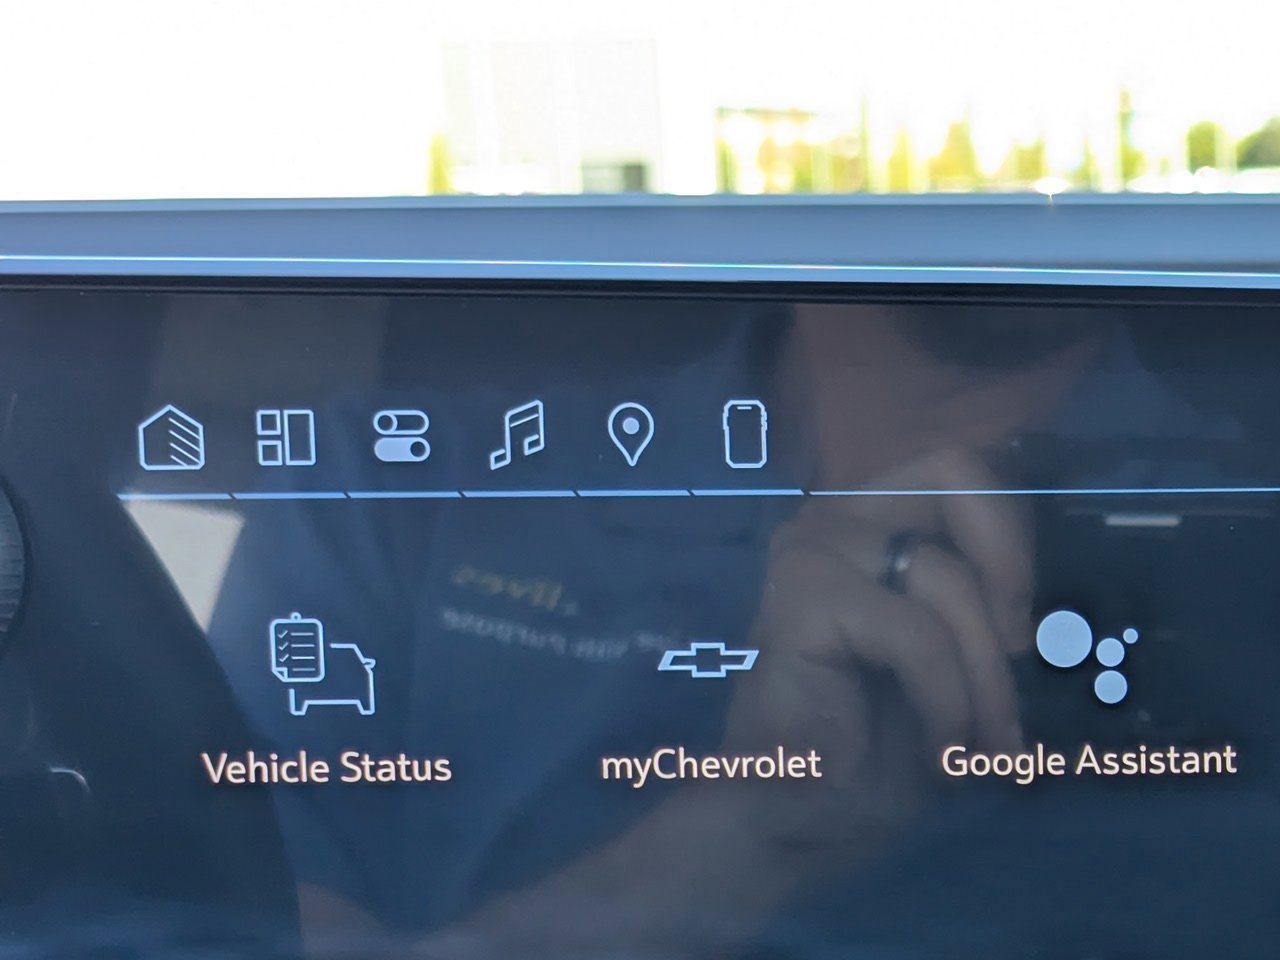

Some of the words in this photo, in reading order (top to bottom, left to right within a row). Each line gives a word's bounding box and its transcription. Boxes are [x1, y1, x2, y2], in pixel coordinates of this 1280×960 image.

[201, 750, 330, 784] Vehicle
[340, 751, 452, 783] Status
[602, 745, 823, 789] myChevrolet
[941, 743, 1066, 785] Google
[1075, 744, 1238, 775] Assistant
